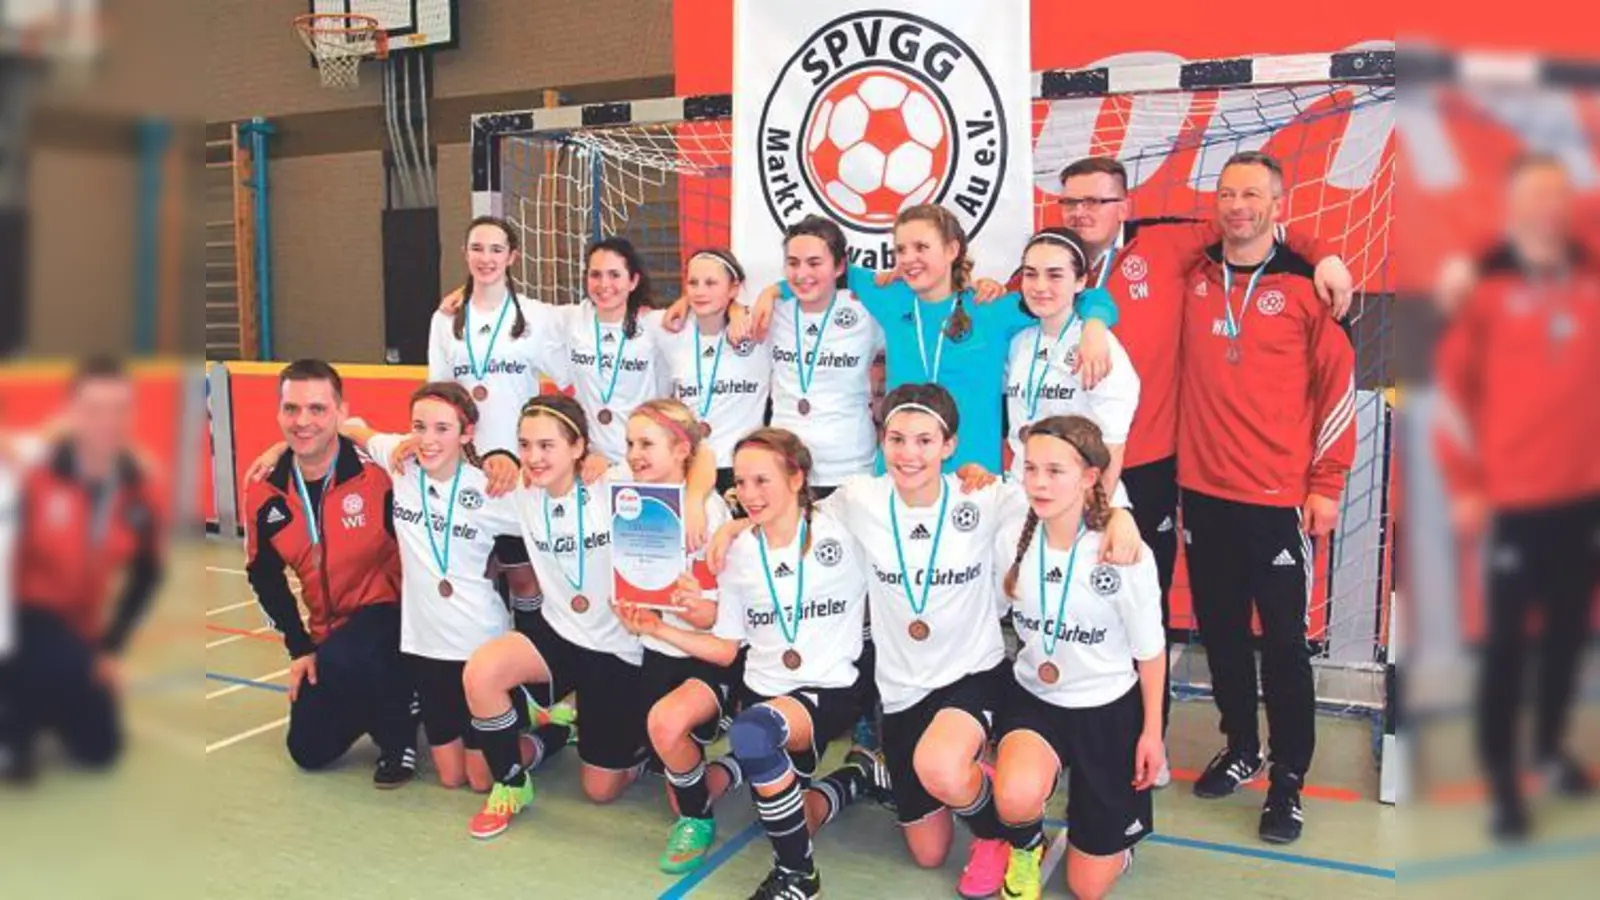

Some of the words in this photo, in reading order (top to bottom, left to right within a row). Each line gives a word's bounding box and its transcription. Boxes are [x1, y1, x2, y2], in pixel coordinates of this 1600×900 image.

[802, 19, 962, 85] SPVGG
[766, 127, 804, 217] Markt
[954, 177, 990, 217] Au
[341, 514, 366, 529] WE
[746, 607, 775, 629] Spor
